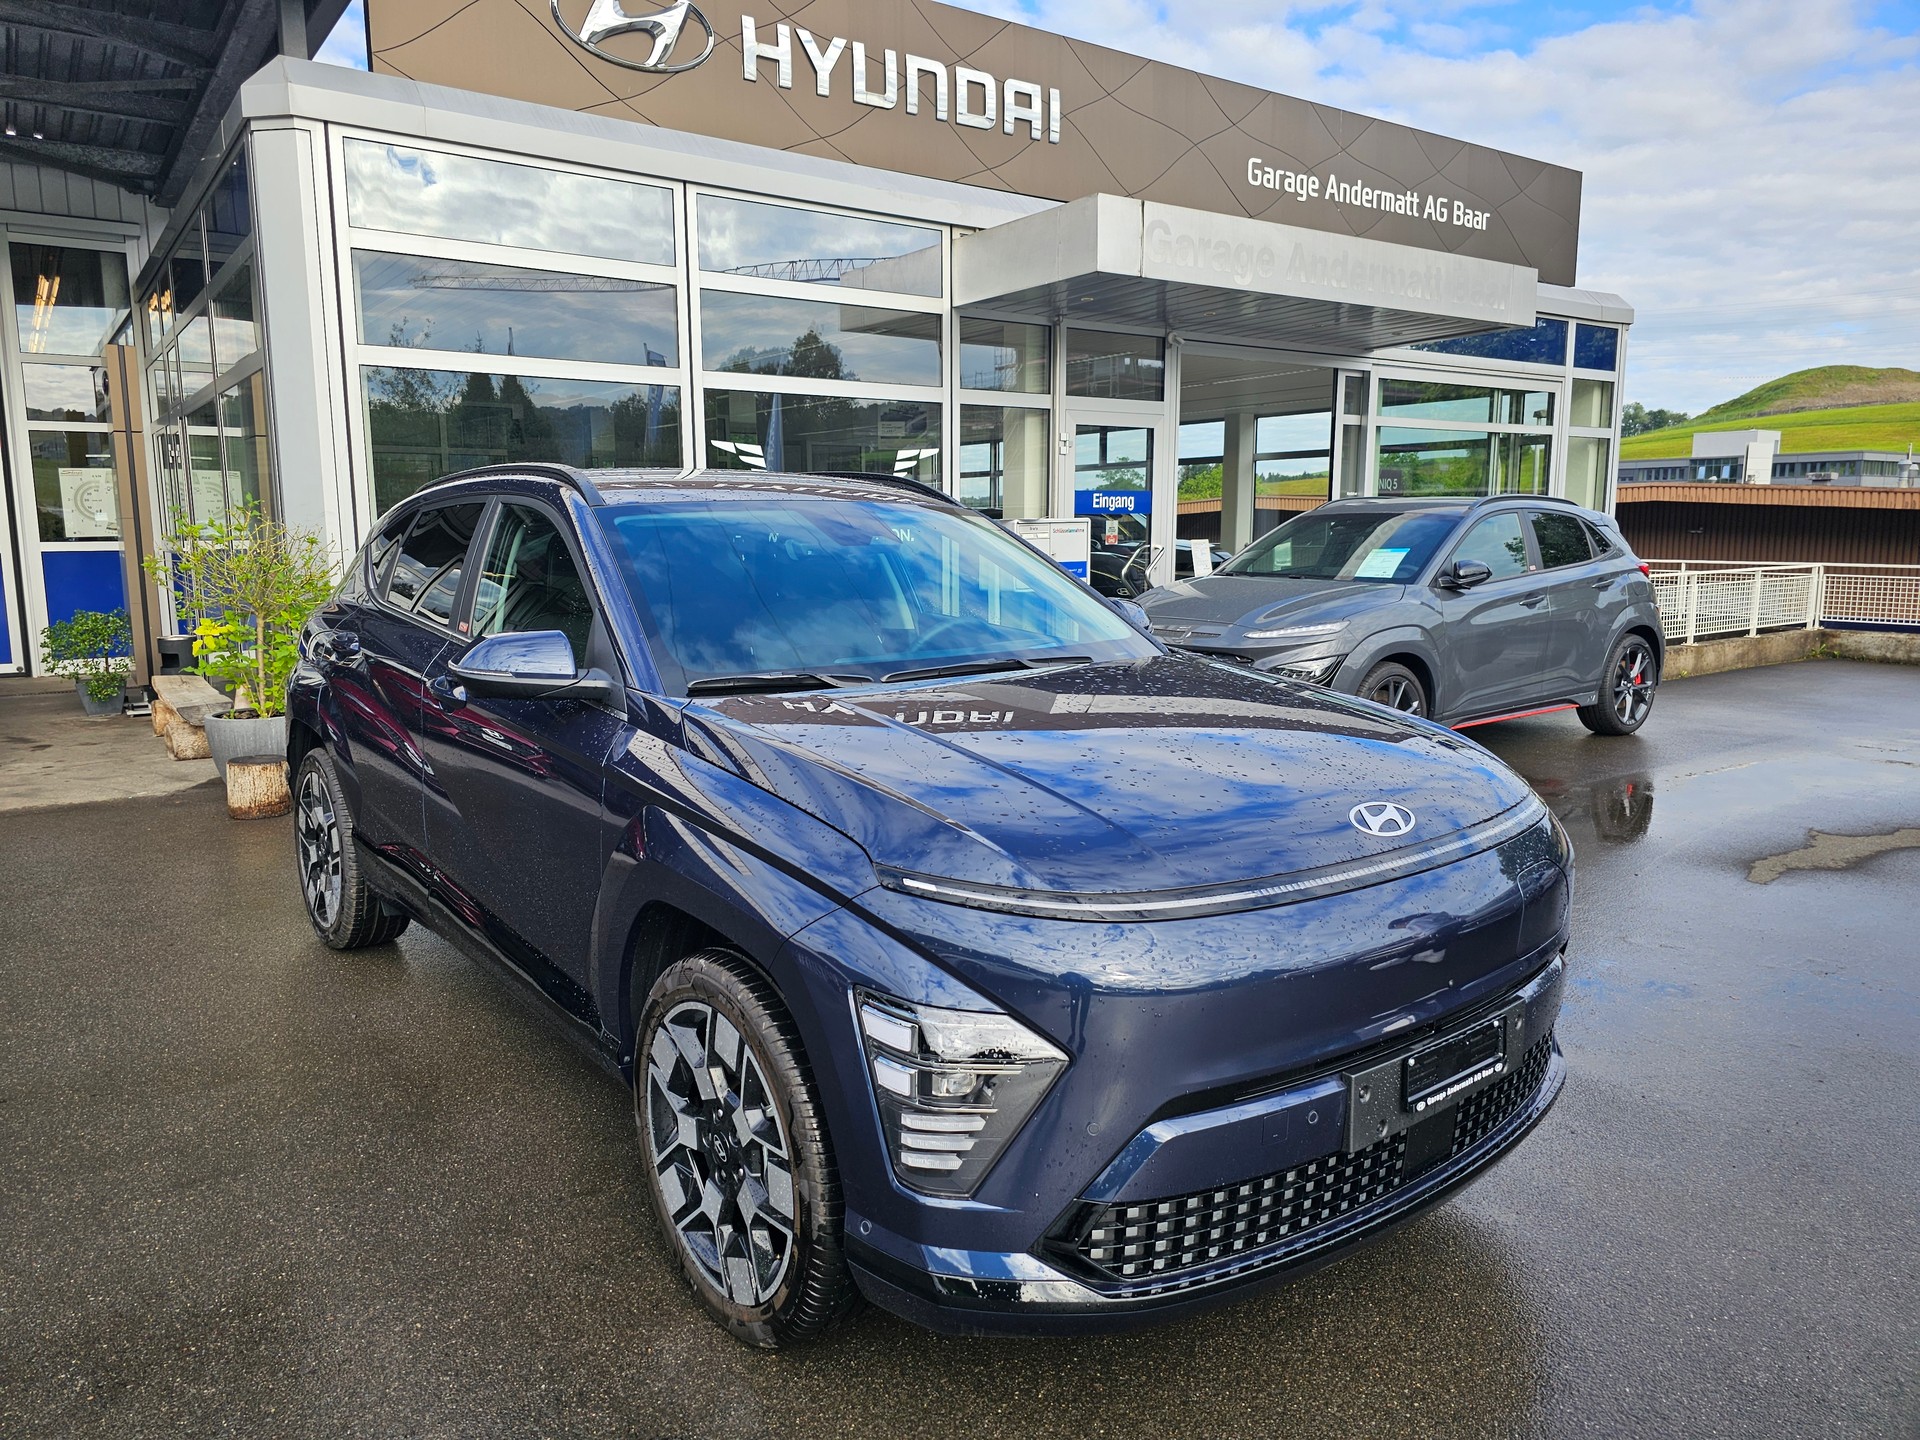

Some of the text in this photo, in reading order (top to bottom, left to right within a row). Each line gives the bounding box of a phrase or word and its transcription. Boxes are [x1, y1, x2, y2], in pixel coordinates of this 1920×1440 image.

[740, 14, 1061, 144] HYUNDAI
[1247, 157, 1491, 231] Garage Andermatt AG Baar
[1145, 219, 1275, 285] Garage
[1092, 493, 1135, 511] Eingang
[1392, 478, 1398, 490] 5
